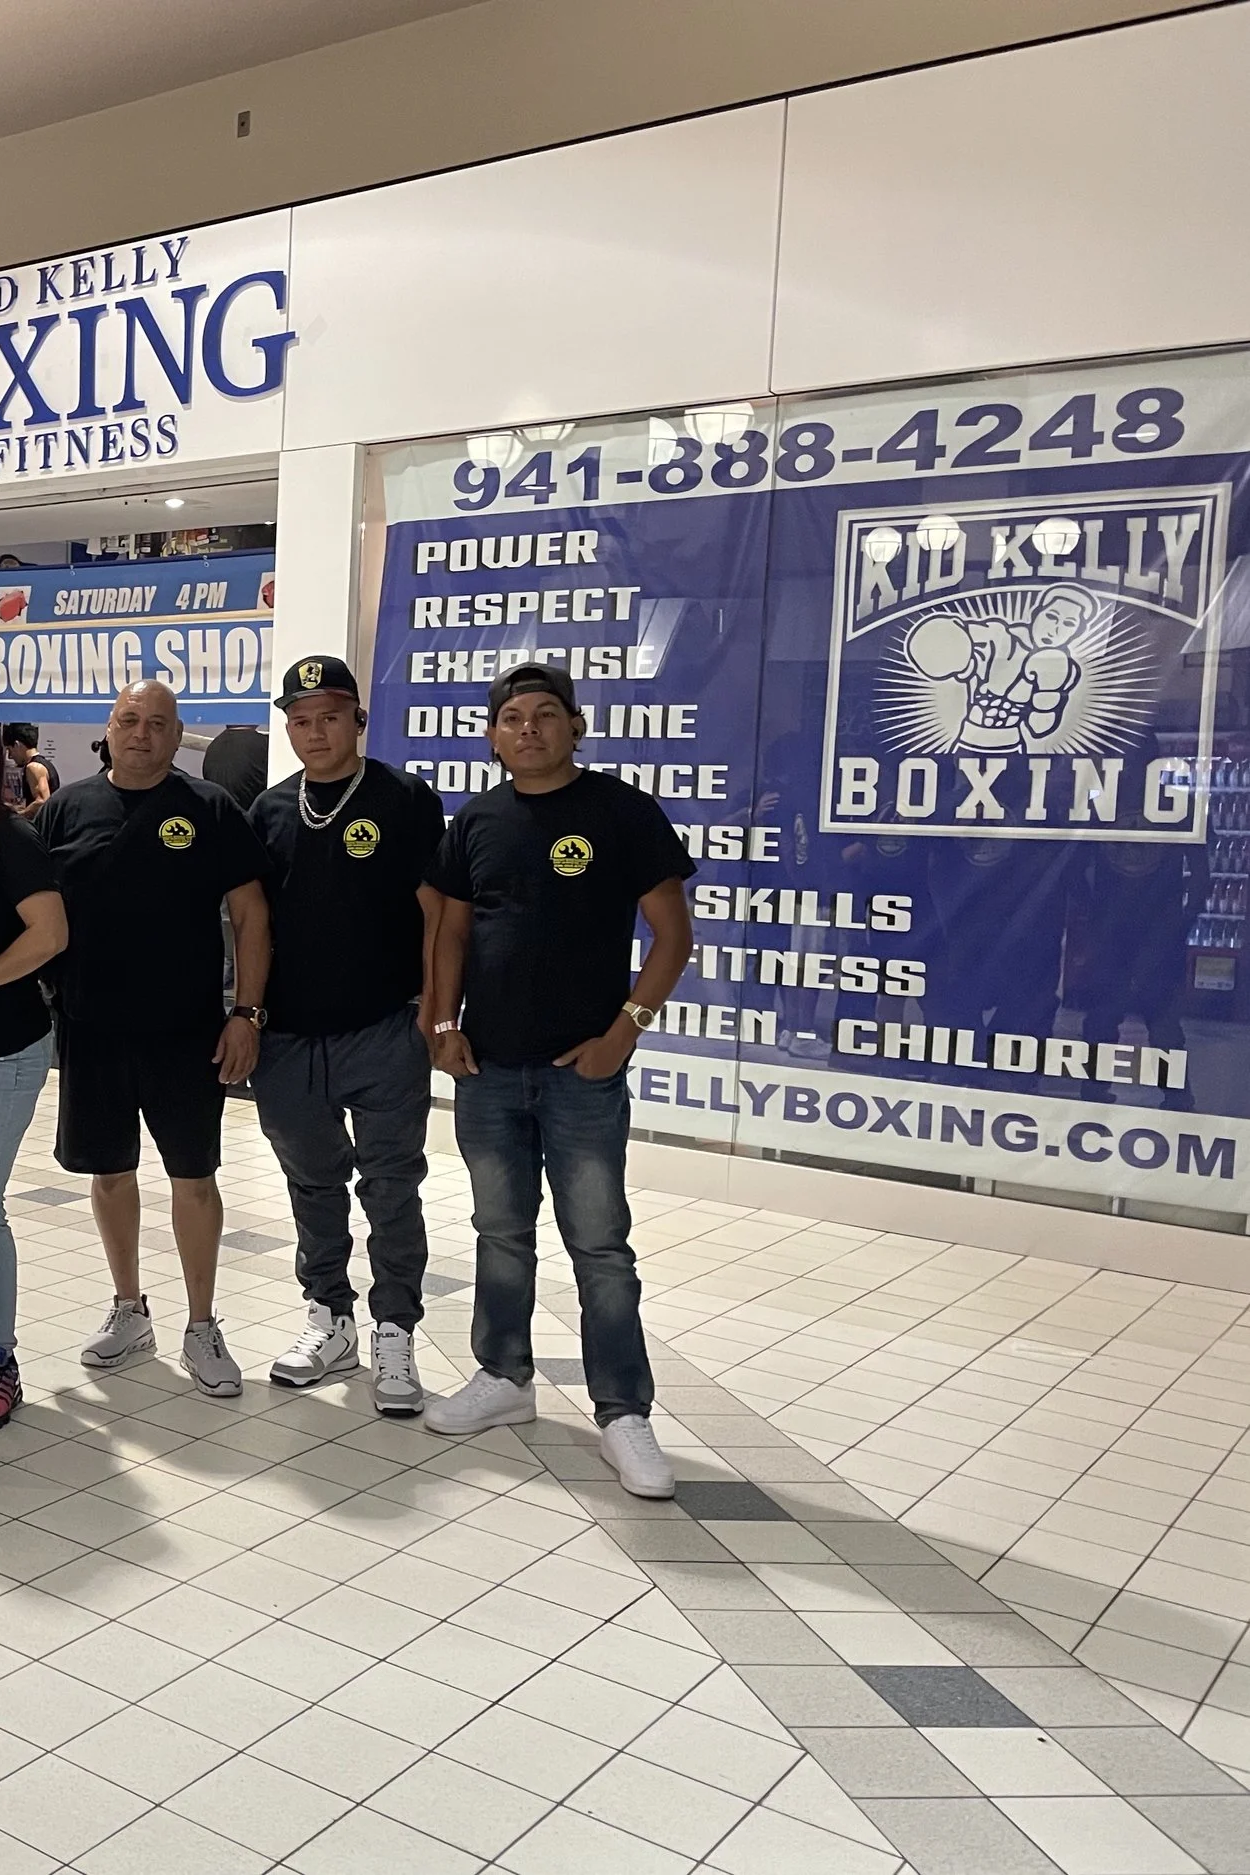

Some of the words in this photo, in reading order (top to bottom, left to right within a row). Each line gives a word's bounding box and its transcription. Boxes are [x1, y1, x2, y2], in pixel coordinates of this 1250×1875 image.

[36, 236, 189, 306] KELLY
[453, 387, 1185, 511] 941-888-4248
[416, 529, 599, 575] POWER
[856, 528, 967, 621] KID
[54, 585, 157, 617] SATURDAY
[413, 586, 641, 629] RESPECT
[408, 704, 699, 739] DISLINE
[405, 759, 729, 800] CONNCE
[836, 757, 1191, 825] BOXING
[693, 884, 913, 933] SKILLS
[647, 1001, 778, 1046] MEN
[837, 1017, 1190, 1090] CHILDREN
